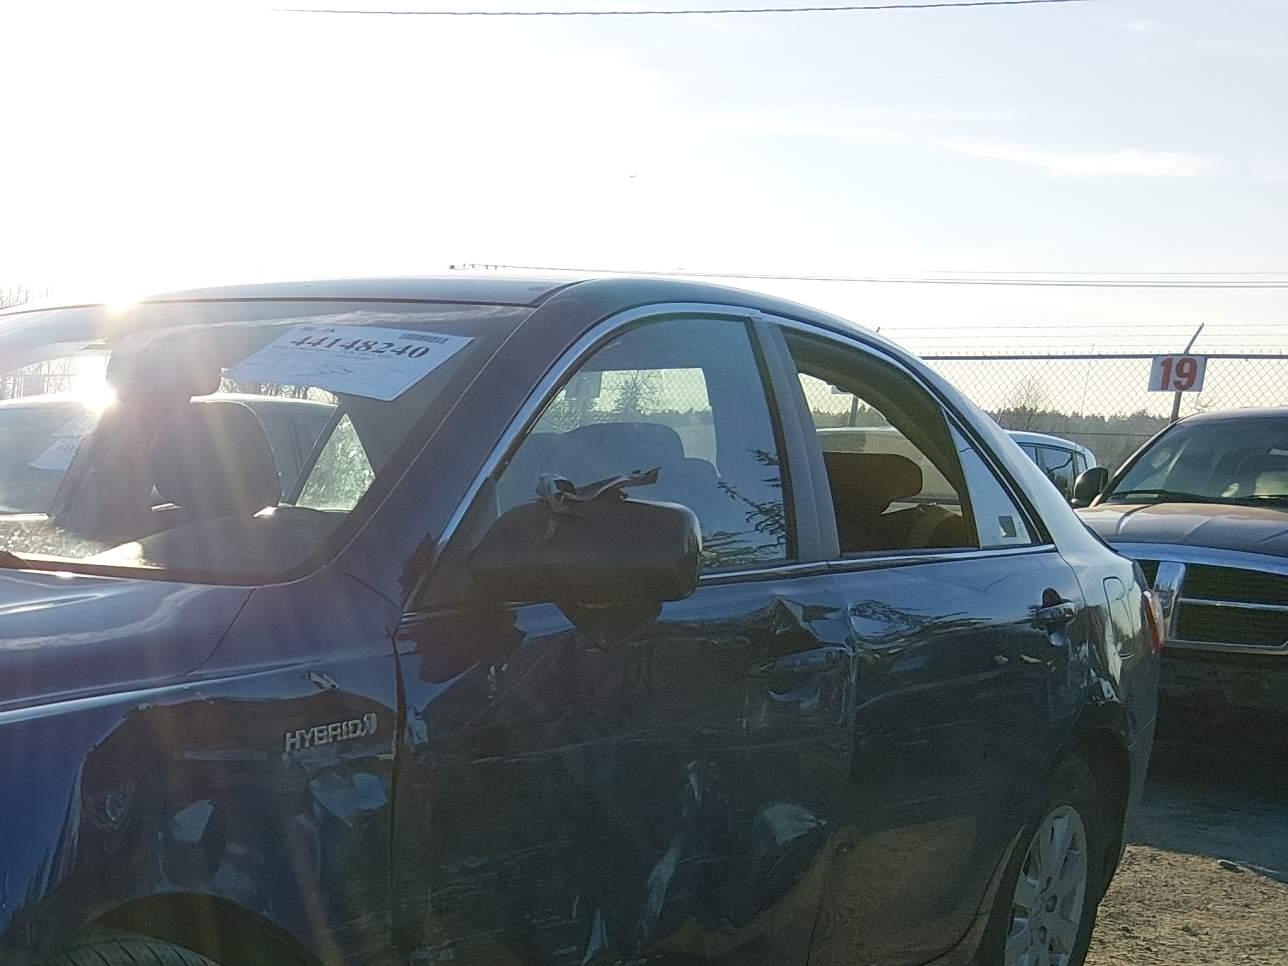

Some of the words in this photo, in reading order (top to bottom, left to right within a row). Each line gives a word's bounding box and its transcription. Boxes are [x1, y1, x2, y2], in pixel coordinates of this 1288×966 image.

[291, 335, 430, 359] 44148240
[1160, 357, 1198, 391] 19
[285, 718, 364, 752] HYBRID
